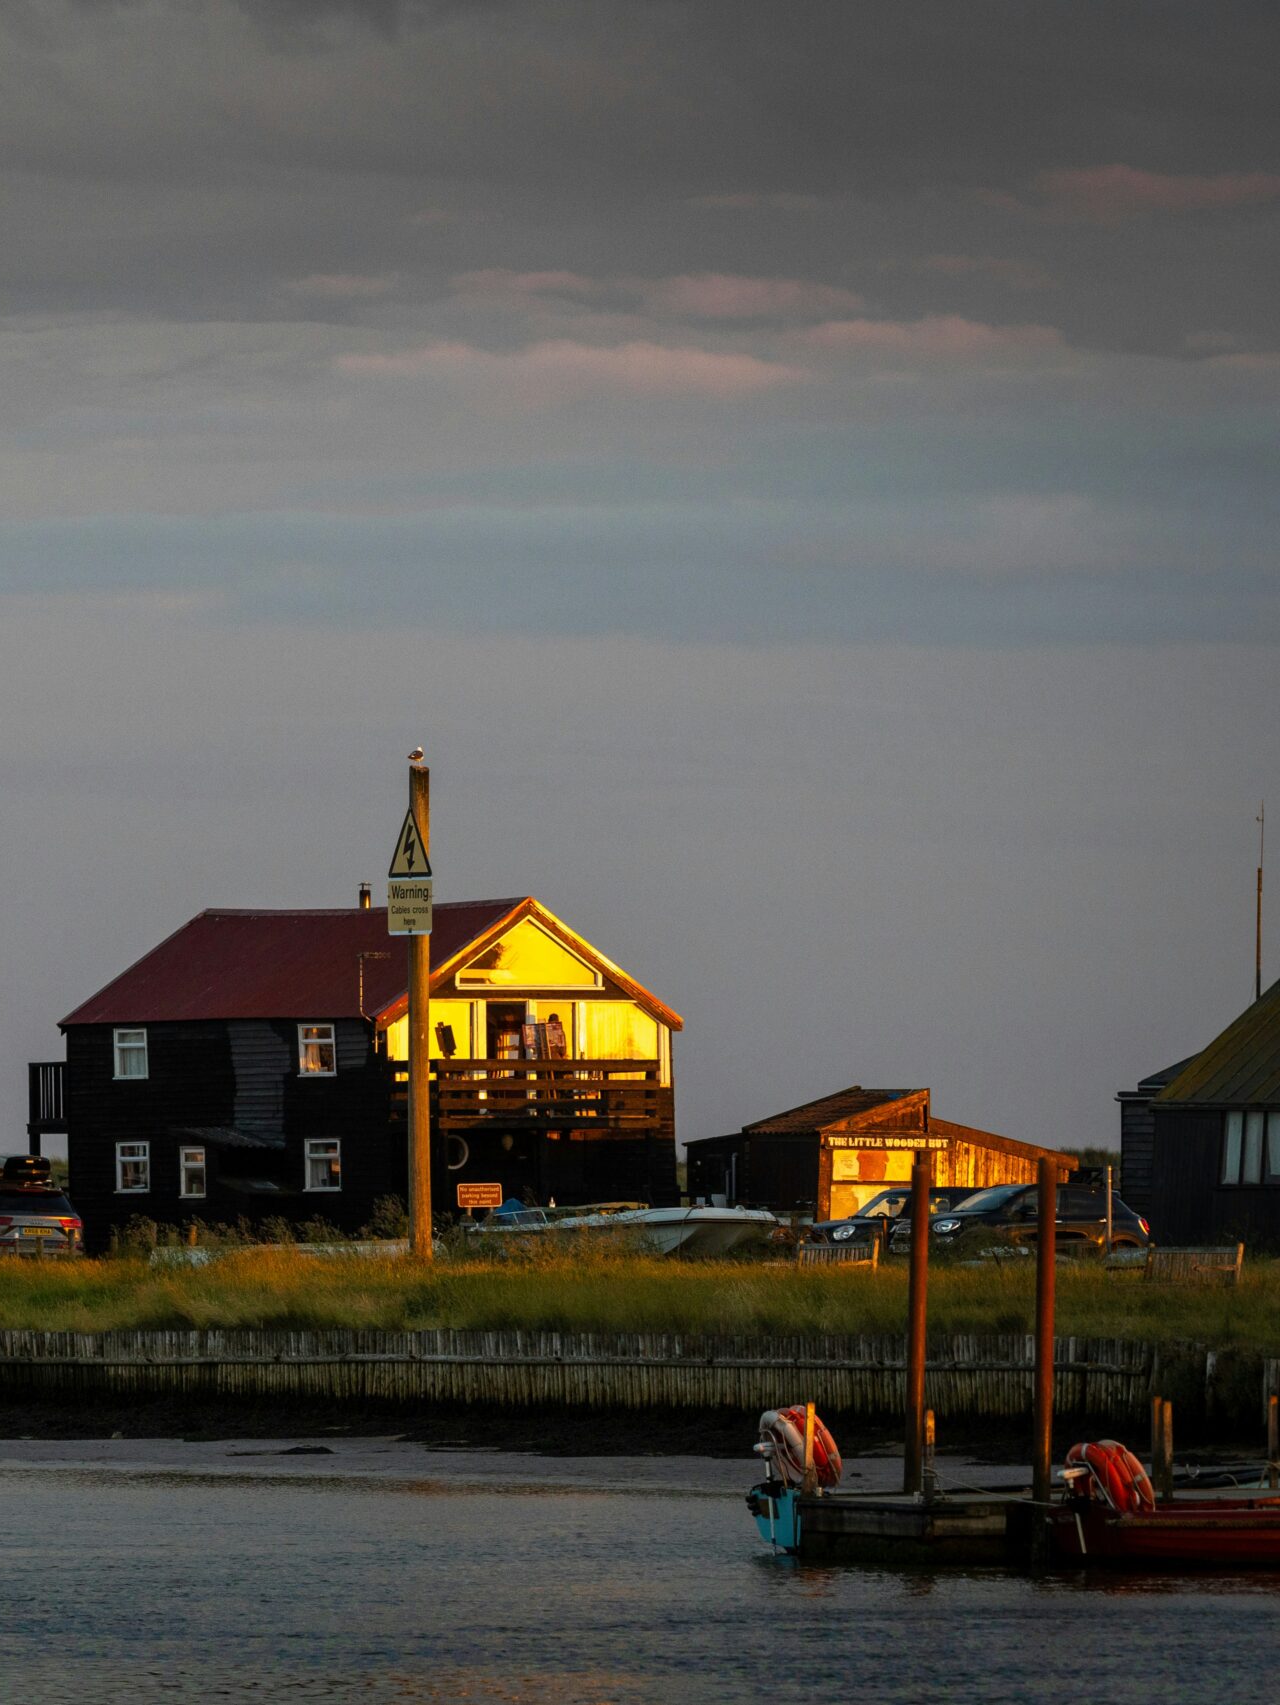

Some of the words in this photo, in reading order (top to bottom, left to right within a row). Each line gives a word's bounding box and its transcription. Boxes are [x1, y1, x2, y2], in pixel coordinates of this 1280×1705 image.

[391, 885, 429, 902] Warning
[391, 905, 410, 914] Cables
[412, 906, 428, 914] cross
[403, 917, 416, 925] here
[828, 1136, 847, 1147] THE
[848, 1137, 883, 1147] LITTLE
[884, 1138, 926, 1148] WOODEN
[928, 1139, 949, 1148] HUT
